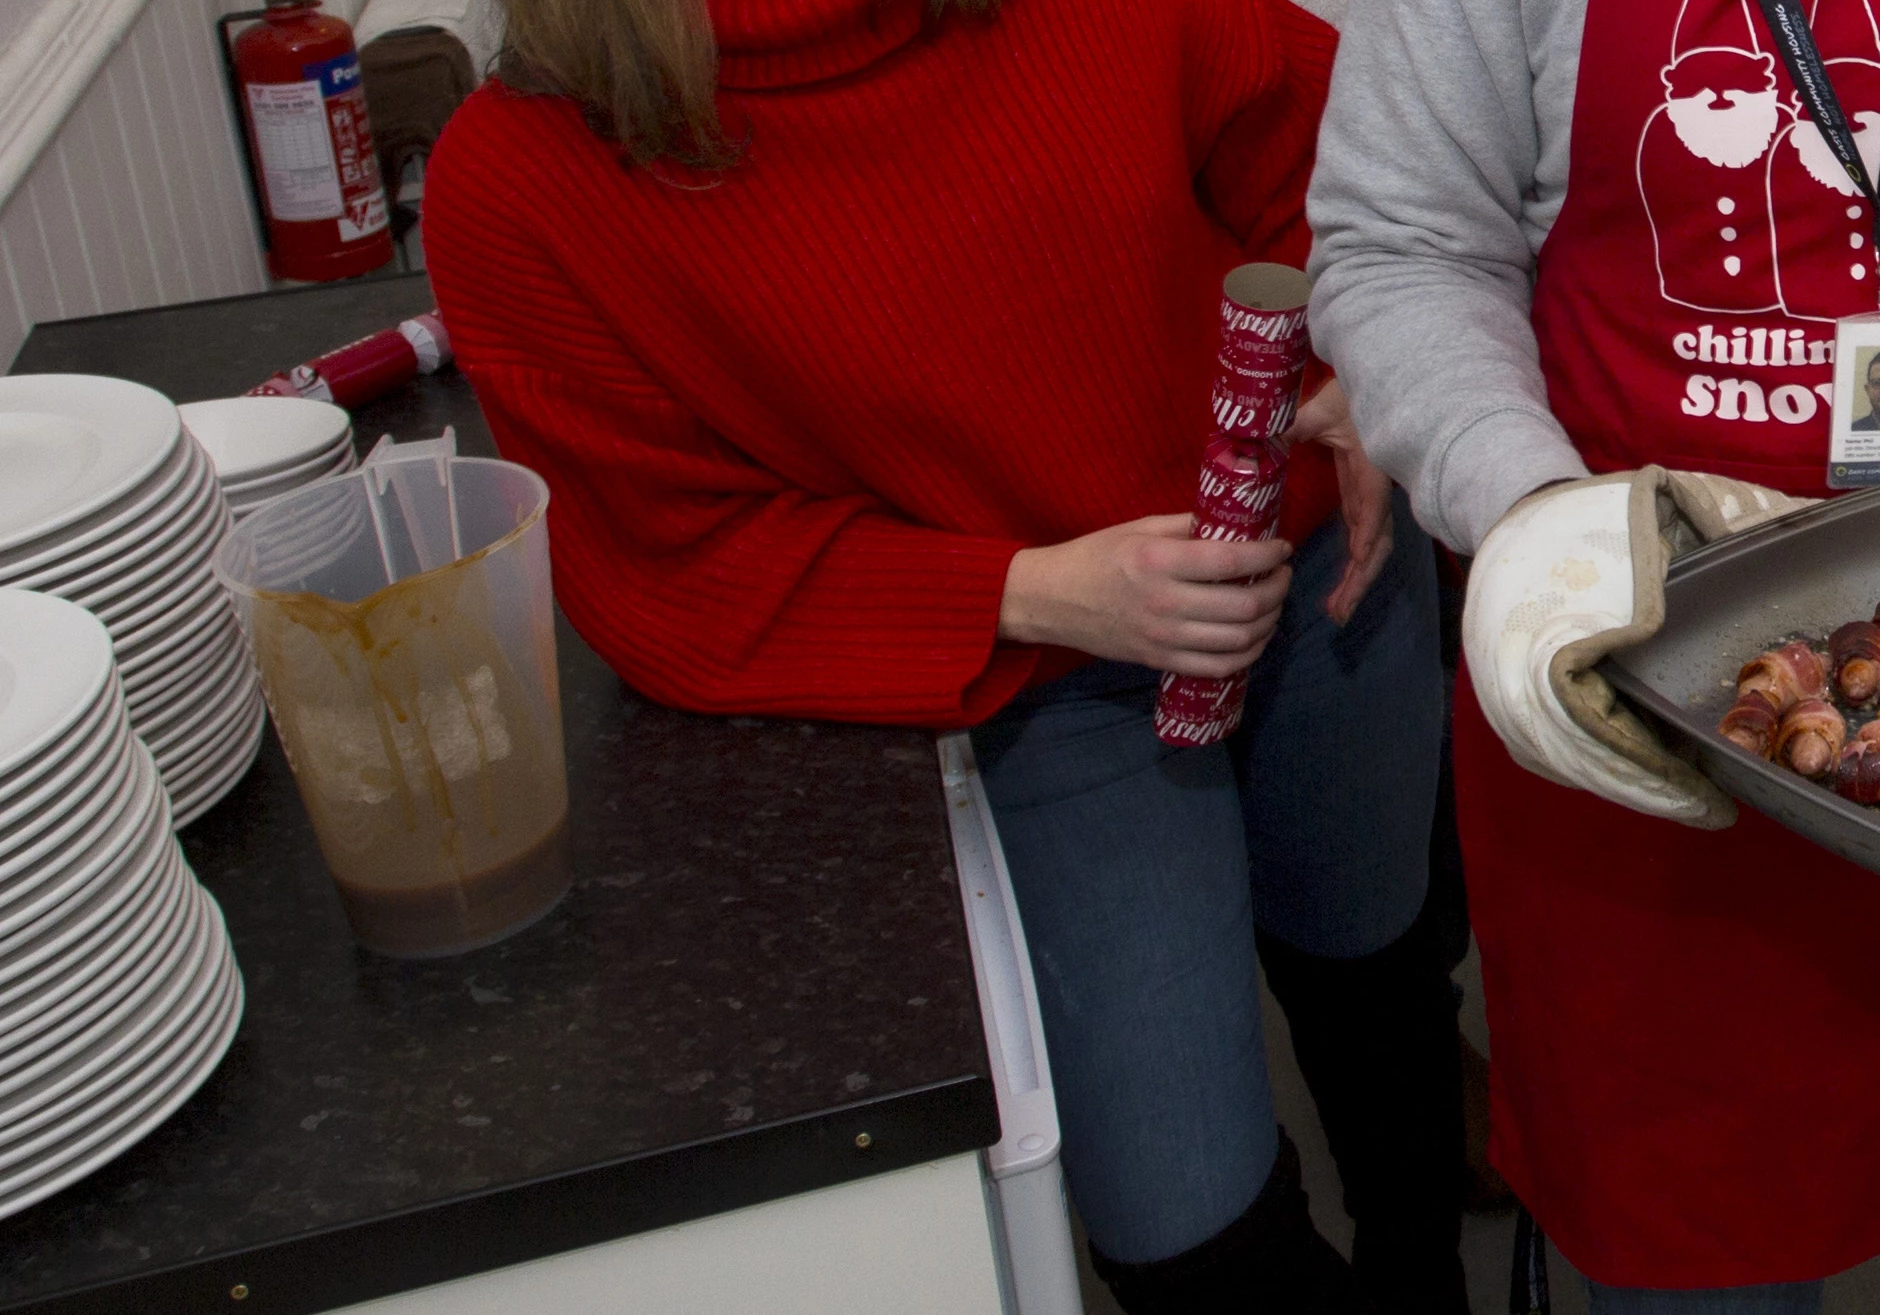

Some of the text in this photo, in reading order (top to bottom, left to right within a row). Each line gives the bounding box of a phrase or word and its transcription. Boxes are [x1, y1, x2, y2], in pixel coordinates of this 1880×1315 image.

[1775, 3, 1851, 161] OASIS COMMUNITY HOUSING
